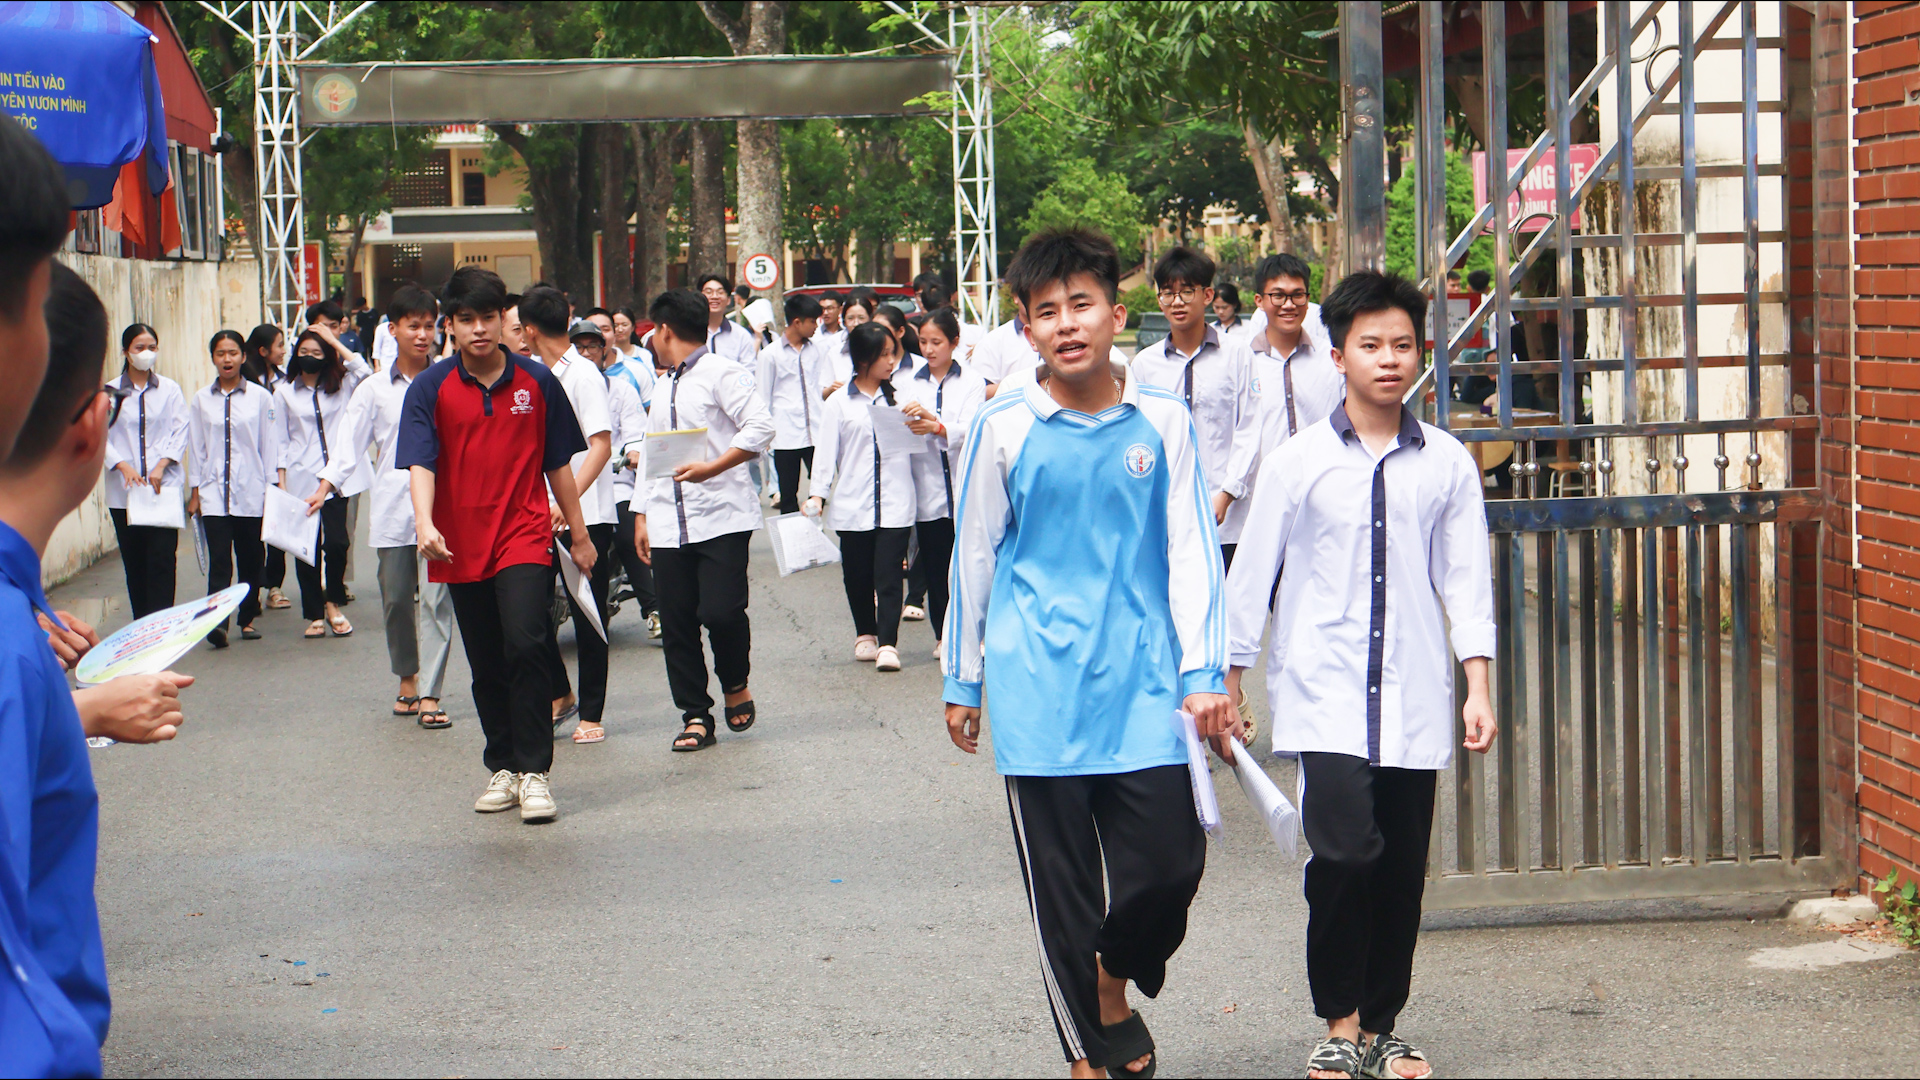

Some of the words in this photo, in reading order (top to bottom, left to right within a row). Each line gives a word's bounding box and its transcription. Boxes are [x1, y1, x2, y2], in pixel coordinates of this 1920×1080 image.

[0, 72, 12, 87] IN
[14, 71, 40, 89] TIẾN
[42, 73, 66, 91] VÀO
[0, 91, 26, 109] YÊN
[28, 95, 59, 111] VƯƠN
[61, 95, 87, 114] MÌNH
[755, 259, 767, 275] 5
